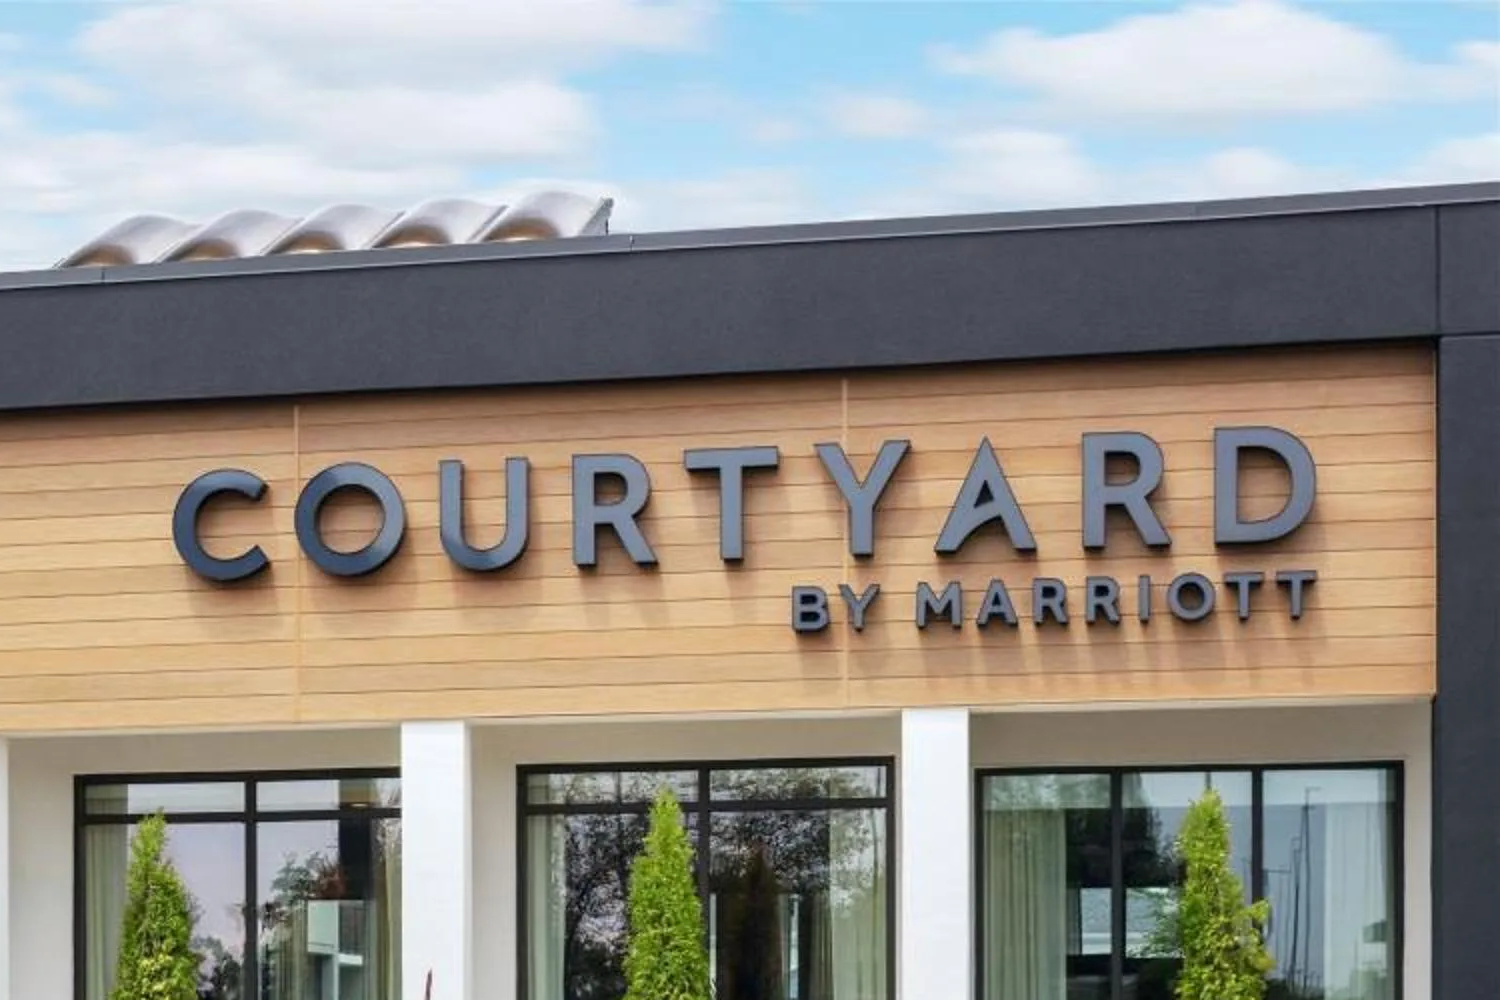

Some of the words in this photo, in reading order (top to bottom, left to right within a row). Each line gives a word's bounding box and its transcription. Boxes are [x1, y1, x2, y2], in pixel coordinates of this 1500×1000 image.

[172, 425, 1318, 582] COURTYARD
[790, 584, 881, 632] BY
[915, 569, 1318, 630] MARRIOTT
